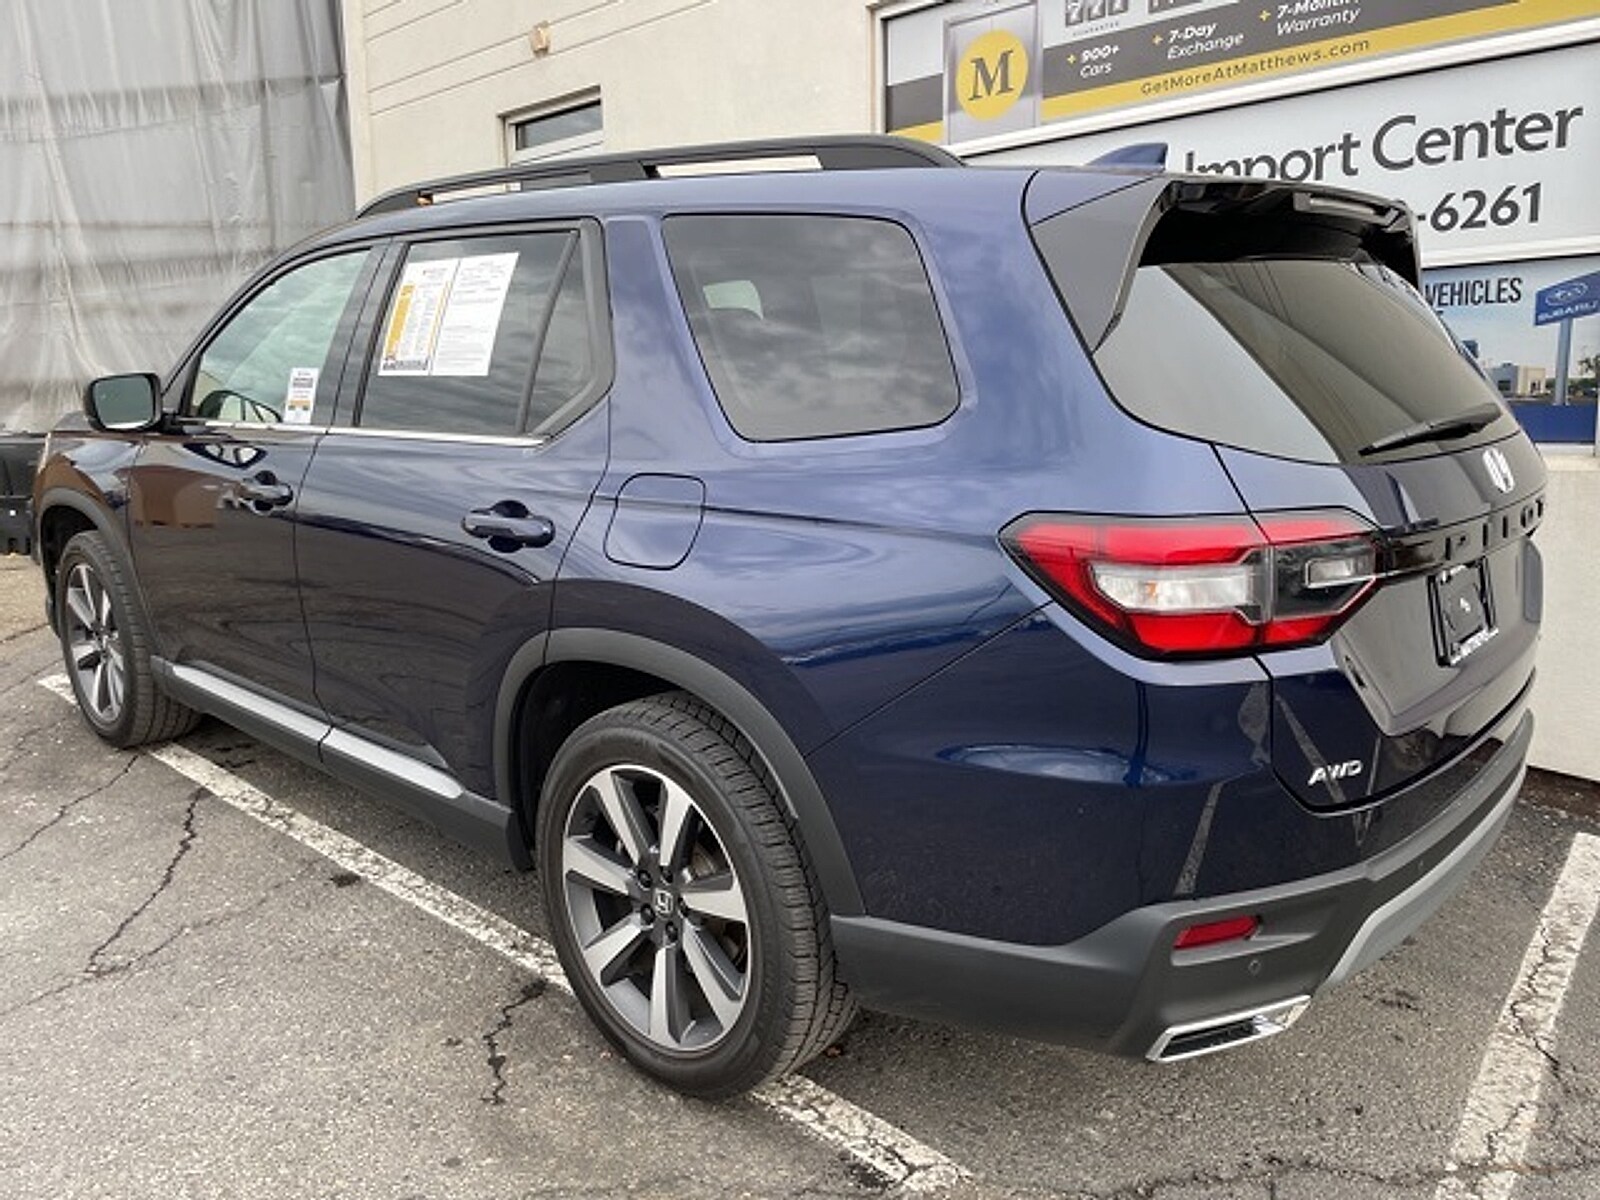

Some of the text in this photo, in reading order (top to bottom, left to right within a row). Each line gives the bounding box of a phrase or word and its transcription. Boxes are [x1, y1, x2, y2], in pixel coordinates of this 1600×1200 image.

[1168, 23, 1217, 43] 7-Day
[1277, 8, 1361, 36] Warranty
[1167, 33, 1244, 59] Exchange
[968, 50, 1014, 101] M
[1080, 62, 1112, 78] Cars
[1140, 40, 1369, 96] GetMoreAtMatthews.com
[1372, 107, 1583, 171] Center
[1425, 277, 1522, 307] VEHICLES
[1308, 760, 1363, 786] AWD
